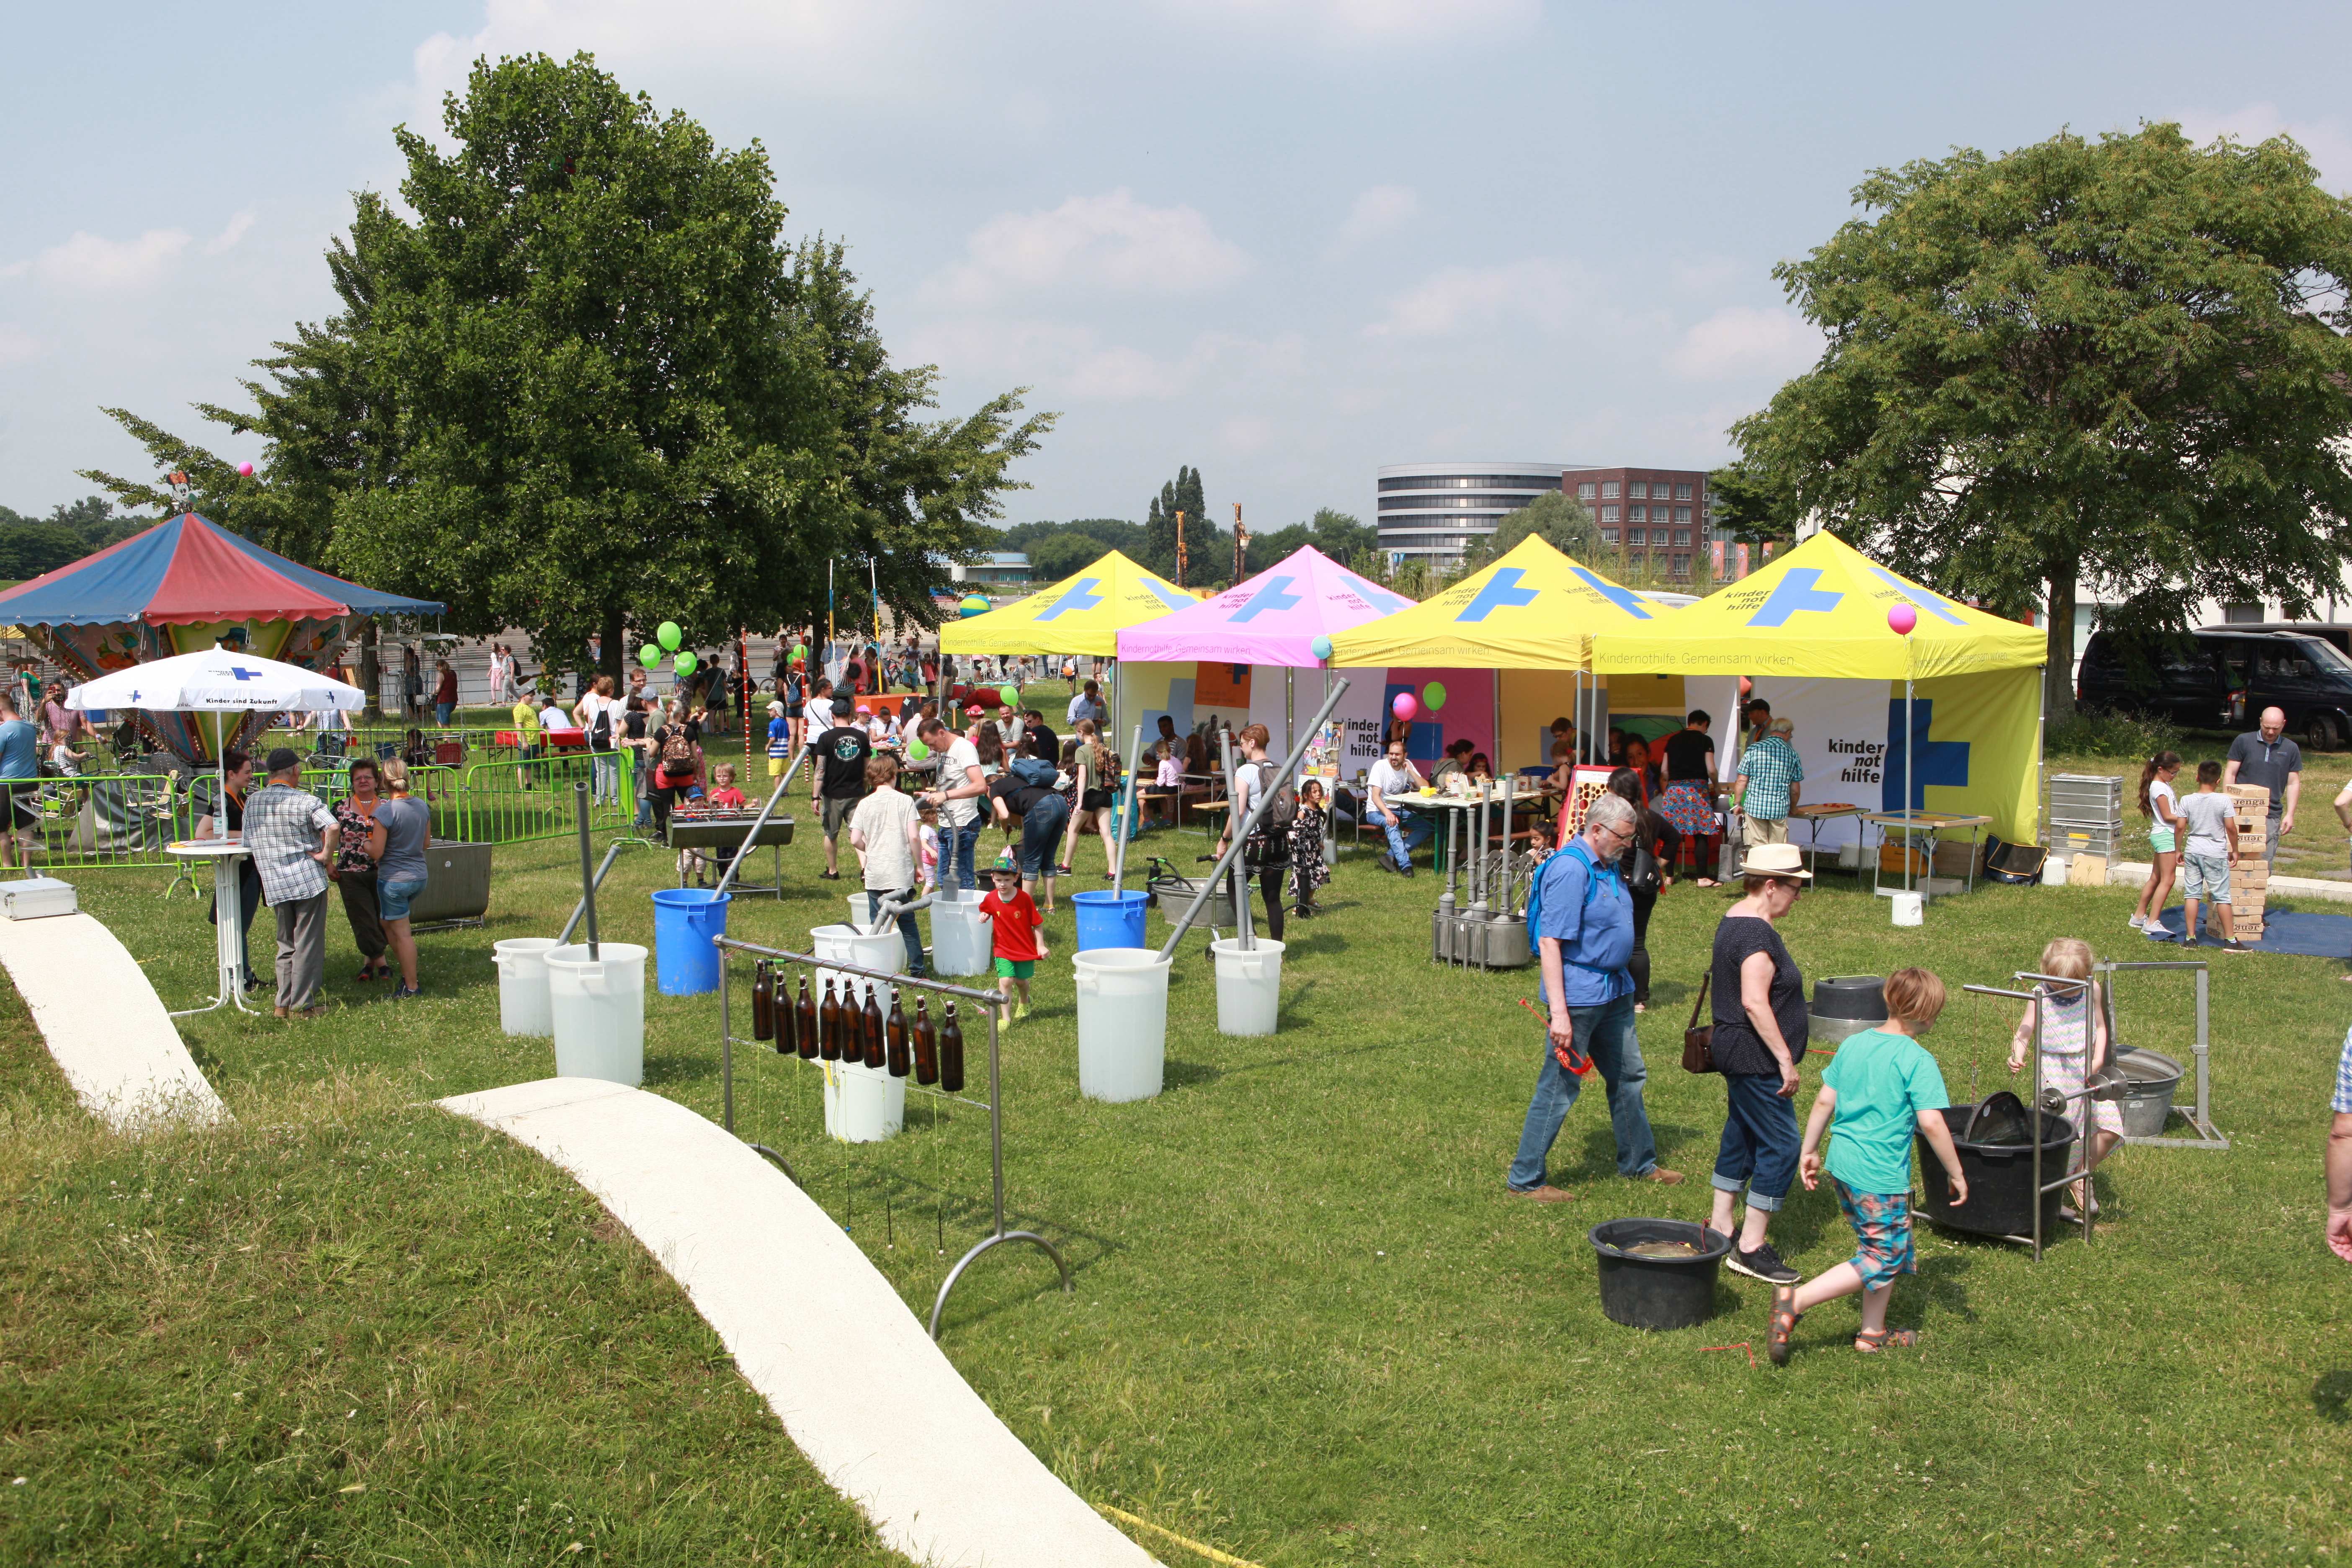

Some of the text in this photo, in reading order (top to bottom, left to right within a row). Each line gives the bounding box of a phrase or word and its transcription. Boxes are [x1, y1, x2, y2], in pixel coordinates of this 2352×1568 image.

[1444, 587, 1481, 596] kinder
[1563, 586, 1594, 595] kinder
[1724, 589, 1772, 599] kinder
[1870, 589, 1900, 599] kinder
[989, 638, 1027, 647] Gemeinsam
[1028, 640, 1051, 648] wirken.
[1121, 644, 1252, 655] Kindernothilfe. Gemeinsam wirken.
[1398, 645, 1455, 655] Gemeinsam
[1458, 645, 1492, 655] wirken.
[1599, 652, 1798, 665] Kindernothilfe. Gemeinsam wirken.
[1956, 652, 1990, 665] Gemeinsam
[1346, 718, 1380, 731] inder
[1359, 732, 1378, 743] not
[1351, 744, 1378, 757] hilfe
[1828, 739, 1884, 754] kinder
[1854, 755, 1881, 767] not
[1841, 768, 1880, 783] hilfe
